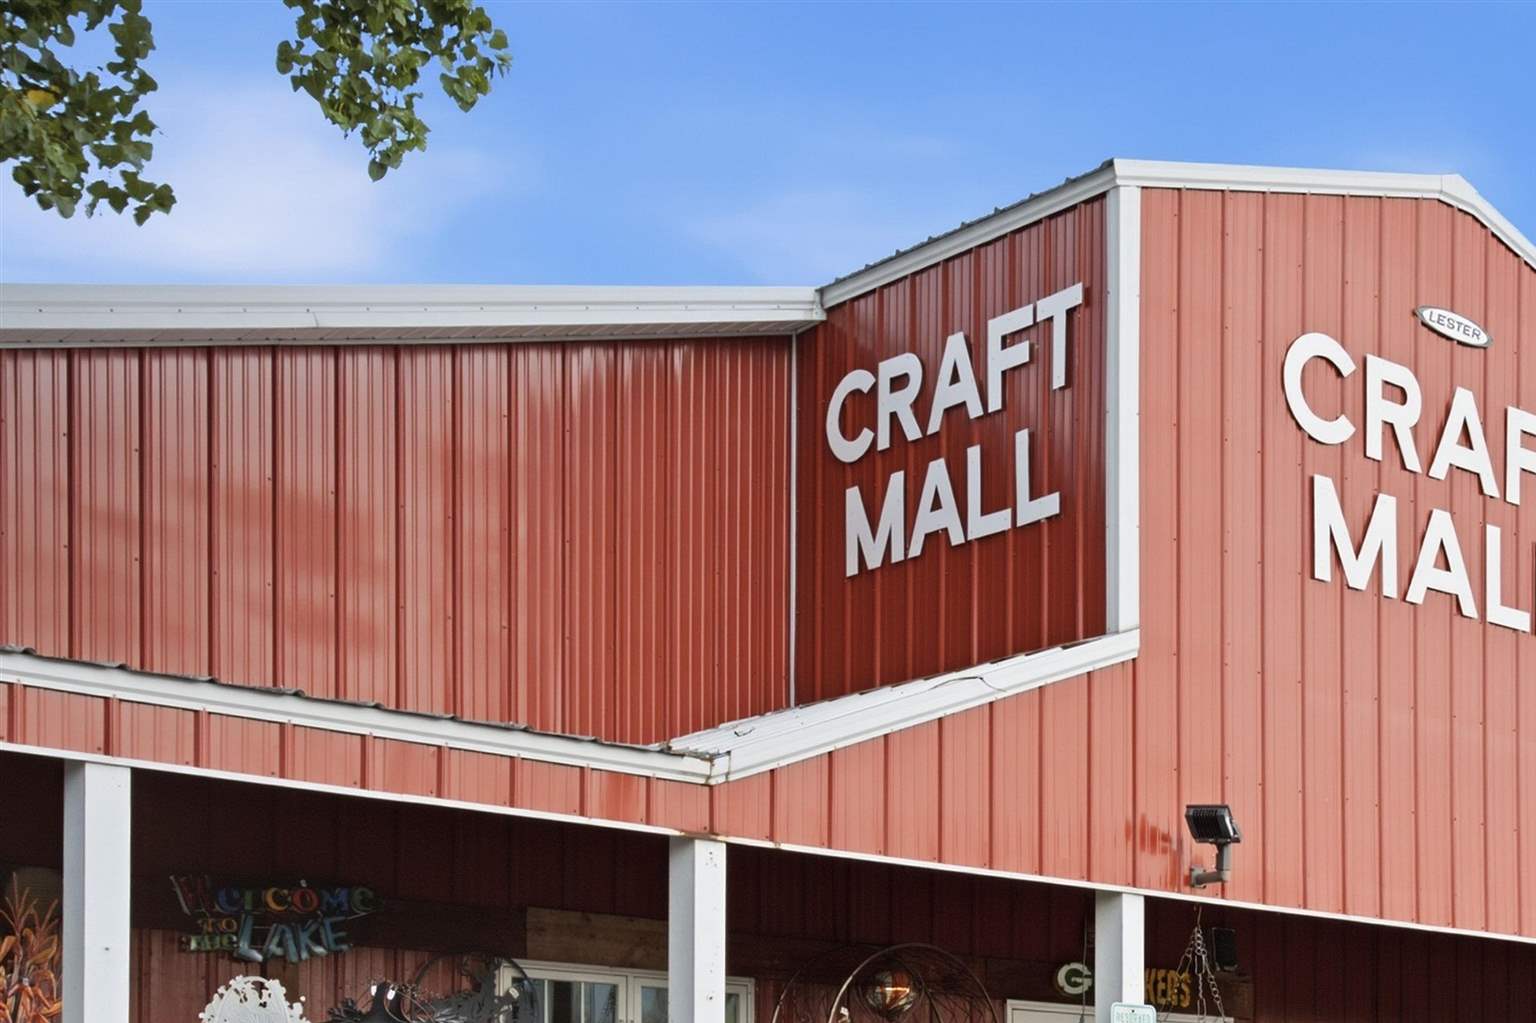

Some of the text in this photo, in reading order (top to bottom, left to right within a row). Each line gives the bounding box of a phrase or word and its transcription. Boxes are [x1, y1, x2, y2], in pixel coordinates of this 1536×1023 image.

[826, 283, 1083, 464] CRAFT
[1428, 310, 1481, 340] LESTER
[844, 429, 1061, 577] MALL
[237, 912, 353, 964] LAKE
